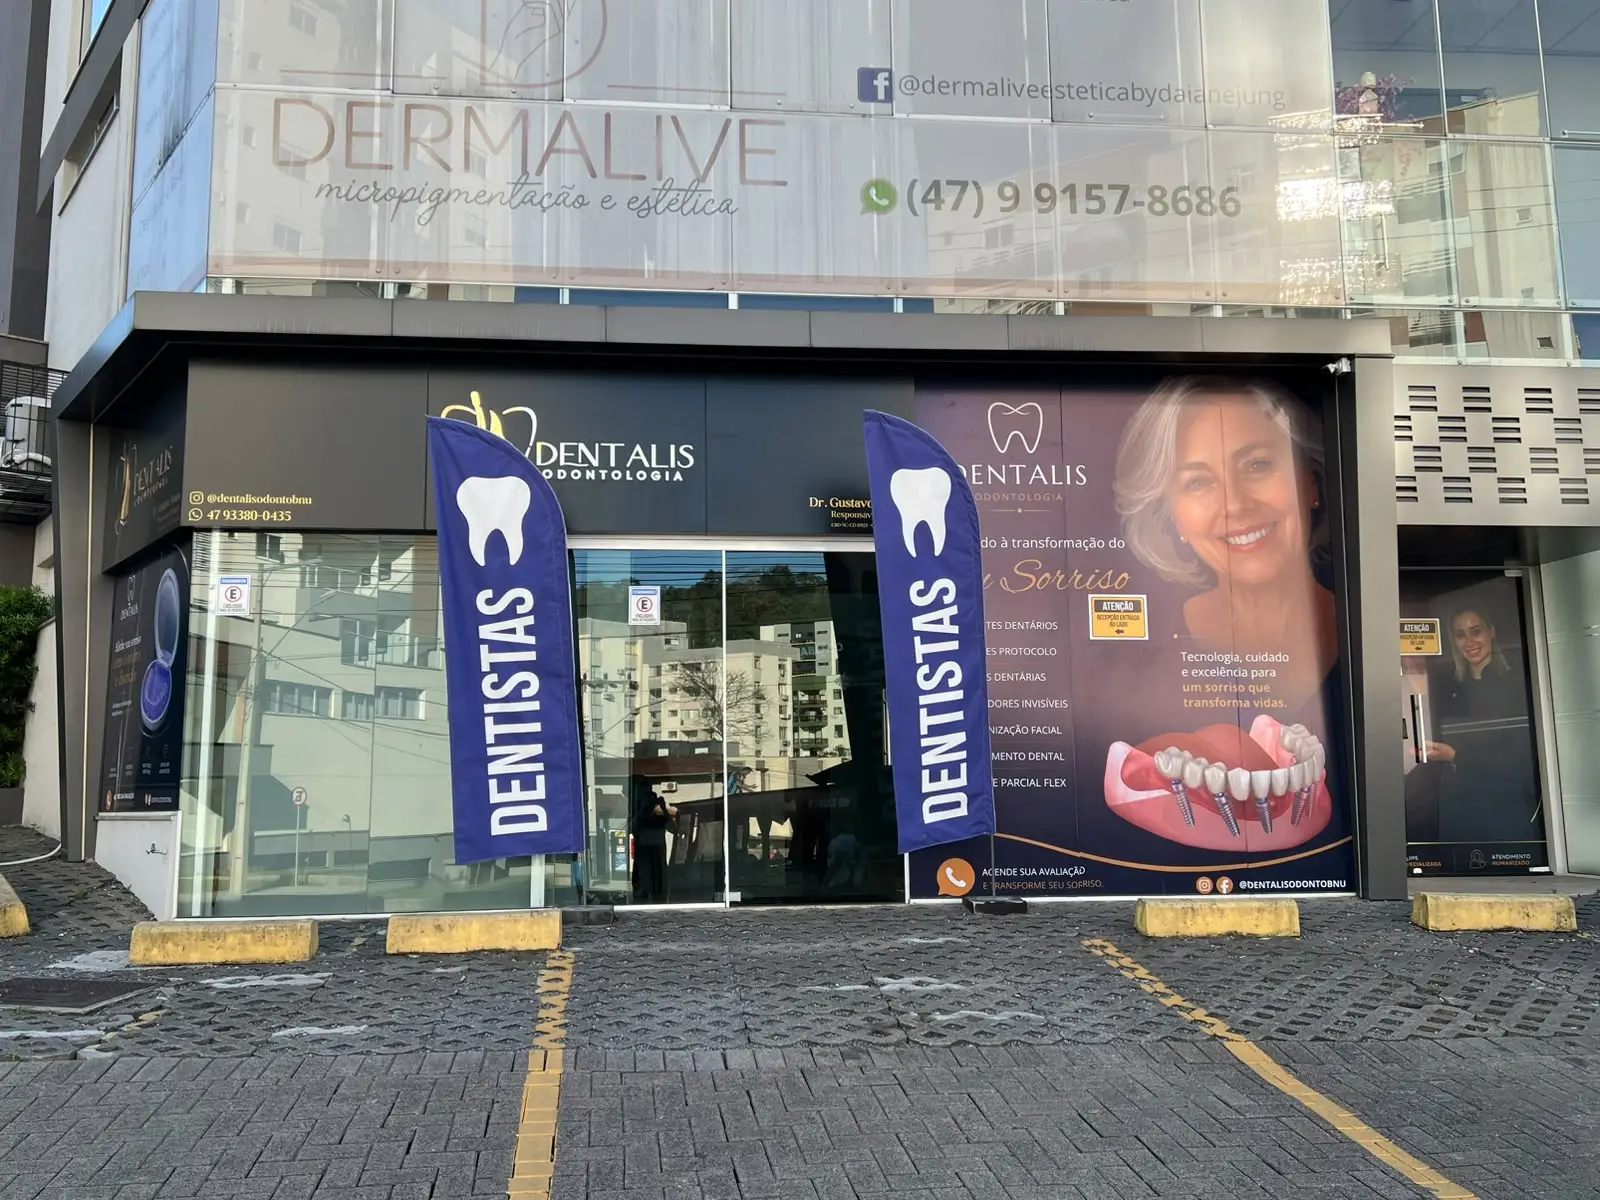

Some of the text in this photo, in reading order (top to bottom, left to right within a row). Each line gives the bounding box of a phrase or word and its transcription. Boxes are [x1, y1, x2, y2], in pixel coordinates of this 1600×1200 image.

[898, 73, 1286, 111] @dermaliveesteticabydaianejung
[271, 97, 788, 187] DERMALIVE
[315, 171, 739, 227] micropigmentação e estética
[906, 178, 1242, 218] (47) 9 9157-8686
[536, 441, 695, 469] DENTALIS
[542, 469, 684, 482] ODONTOLOGIA
[206, 493, 313, 505] @dentalisodontobnu
[808, 496, 828, 508] Dr.
[974, 492, 1064, 502] ODONTOLOGIA
[206, 509, 292, 522] 47 93380-0435
[1000, 536, 1008, 549] à
[1011, 536, 1105, 551] transformação
[1108, 536, 1126, 549] do
[999, 558, 1132, 595] Sorriso
[1102, 600, 1134, 612] ATENÇÃO
[1004, 619, 1059, 631] DENTÁRIOS
[1404, 623, 1430, 632] ATENÇÃO
[999, 647, 1057, 656] PROTOCOLO
[1180, 651, 1290, 665] Tecnologia, cuidado
[994, 670, 1047, 682] DENTÁRIAS
[1181, 666, 1277, 680] e excelência para
[1182, 682, 1271, 695] um sorriso que
[908, 577, 969, 825] DENTISTAS
[1021, 697, 1069, 709] INVISÍVEIS
[1183, 697, 1288, 708] transforma vidas.
[475, 586, 548, 837] DENTISTAS
[1031, 726, 1063, 735] FACIAL
[991, 752, 1065, 761] MENTO DENTAL
[1001, 778, 1042, 788] PARCIAL
[1043, 778, 1067, 788] FLEX
[981, 866, 1086, 878] AGENDE SUA AVALIAÇÃO
[1048, 881, 1065, 889] SEU
[1239, 879, 1347, 890] @DENTALISODONTOBNU
